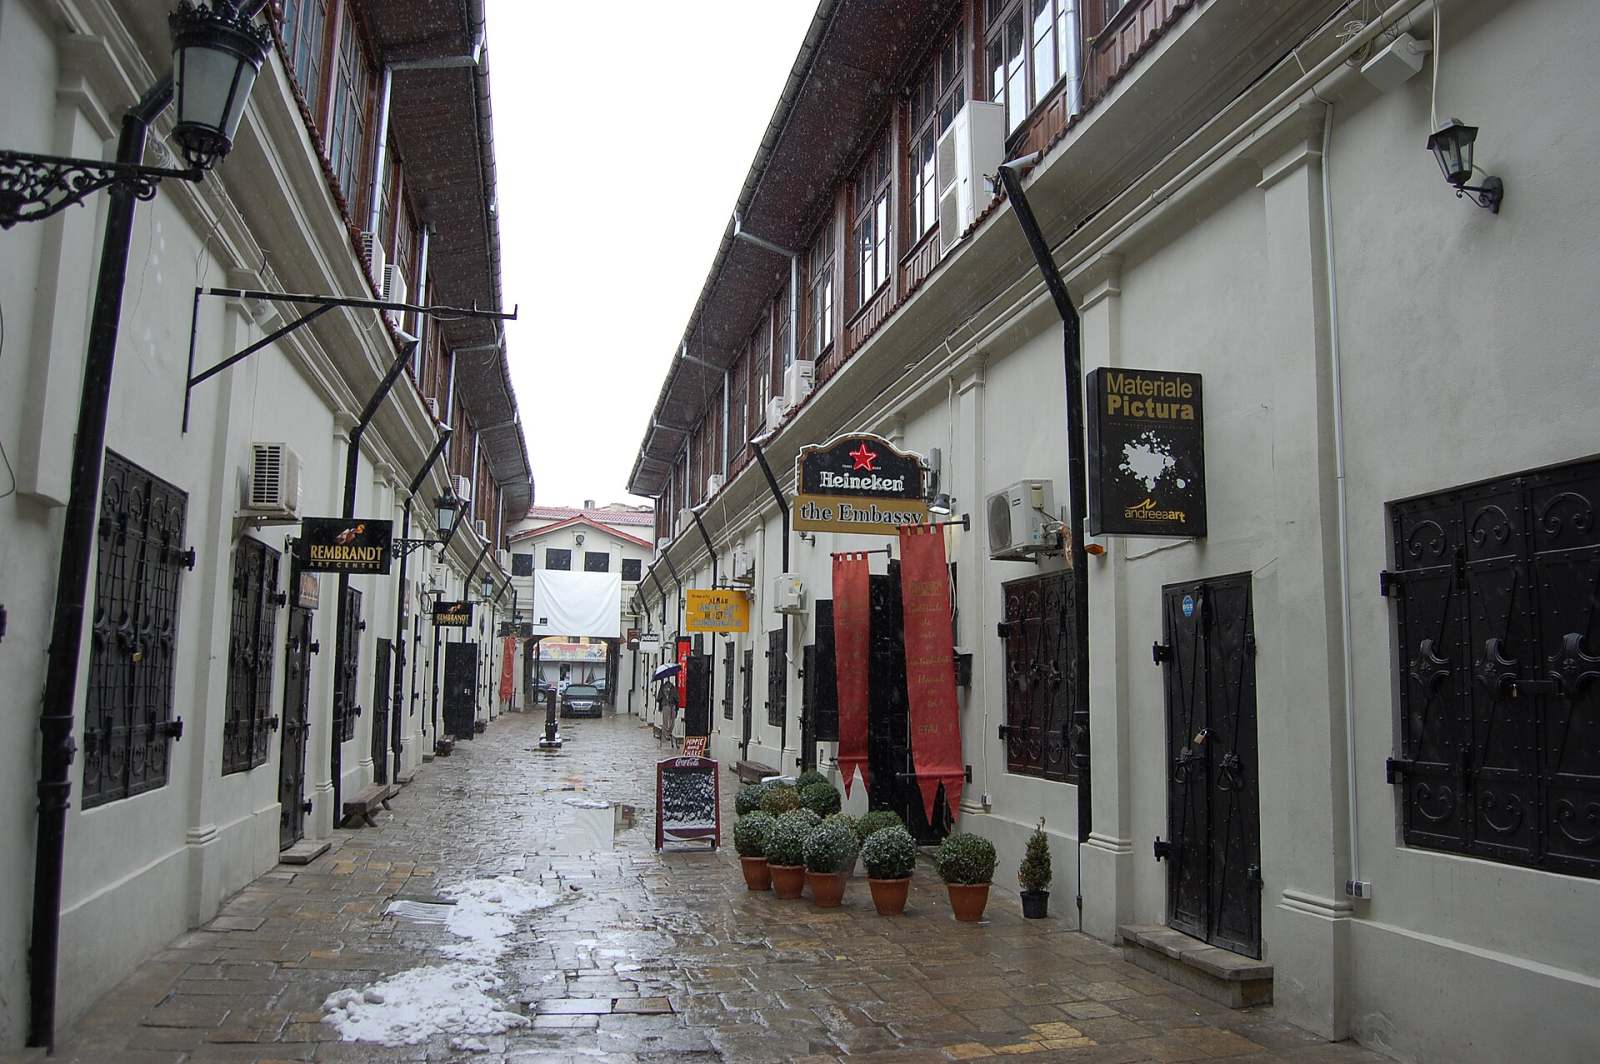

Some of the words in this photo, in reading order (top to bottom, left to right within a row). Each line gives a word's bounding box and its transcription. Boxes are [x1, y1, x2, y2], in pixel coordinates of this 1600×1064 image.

[1106, 372, 1193, 399] Materiale
[1107, 394, 1195, 420] Pictura
[819, 471, 905, 492] Heineken
[800, 502, 832, 521] the
[838, 503, 922, 525] Embassy
[310, 544, 383, 561] REMBRANDT
